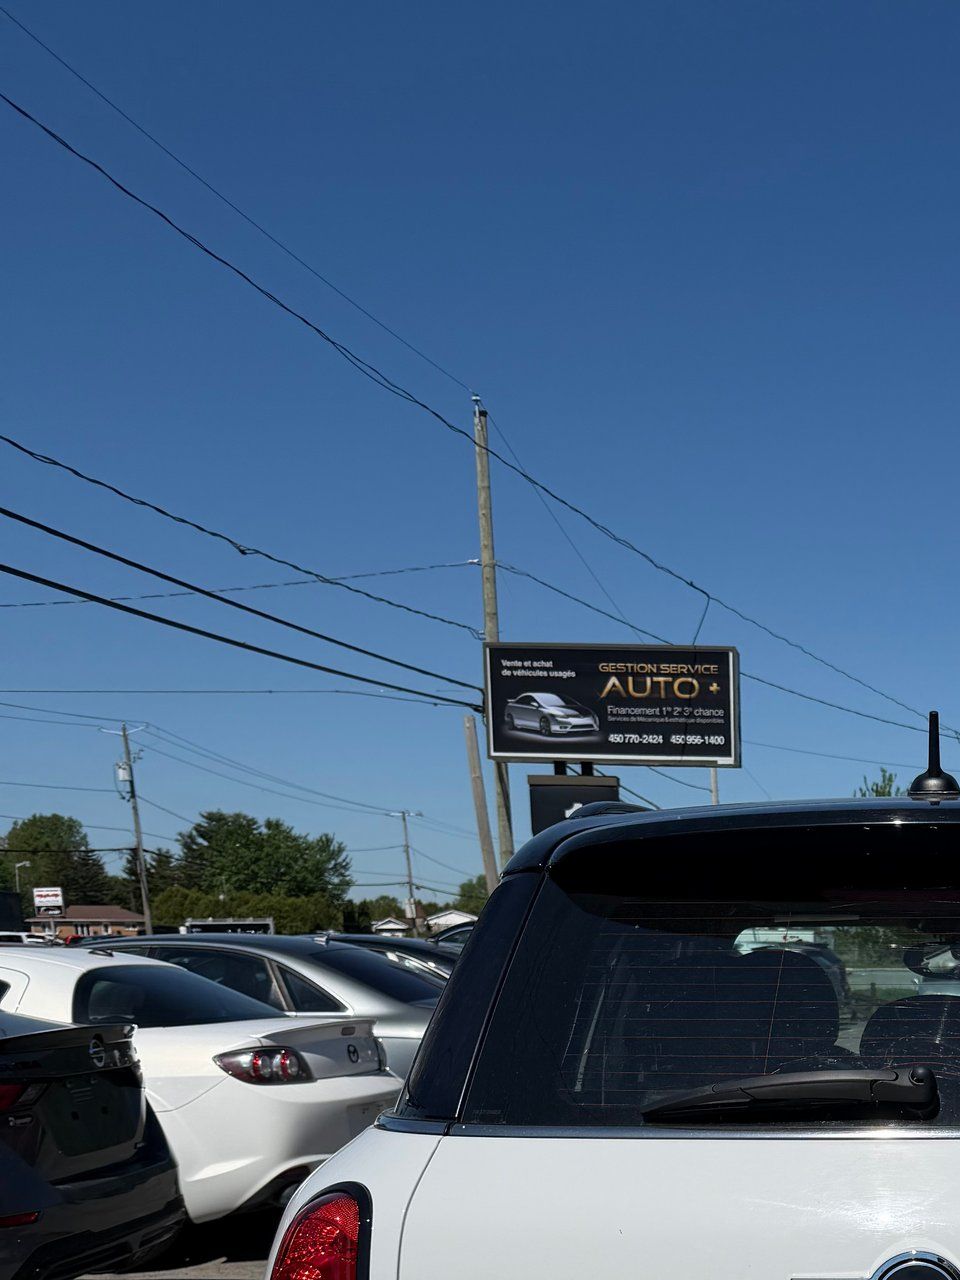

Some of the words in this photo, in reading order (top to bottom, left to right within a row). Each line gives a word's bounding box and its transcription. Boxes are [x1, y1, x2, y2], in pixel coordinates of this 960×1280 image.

[501, 659, 522, 667] Vente
[532, 660, 553, 668] achat
[599, 663, 657, 673] GESTION
[660, 664, 719, 674] SERVICE
[512, 669, 548, 677] véhicules
[549, 670, 576, 678] usagés
[600, 676, 699, 698] AUTO
[607, 705, 660, 716] Financement
[694, 708, 724, 717] chance
[608, 734, 623, 743] 450
[624, 734, 664, 744] 770-2424
[670, 735, 685, 744] 450
